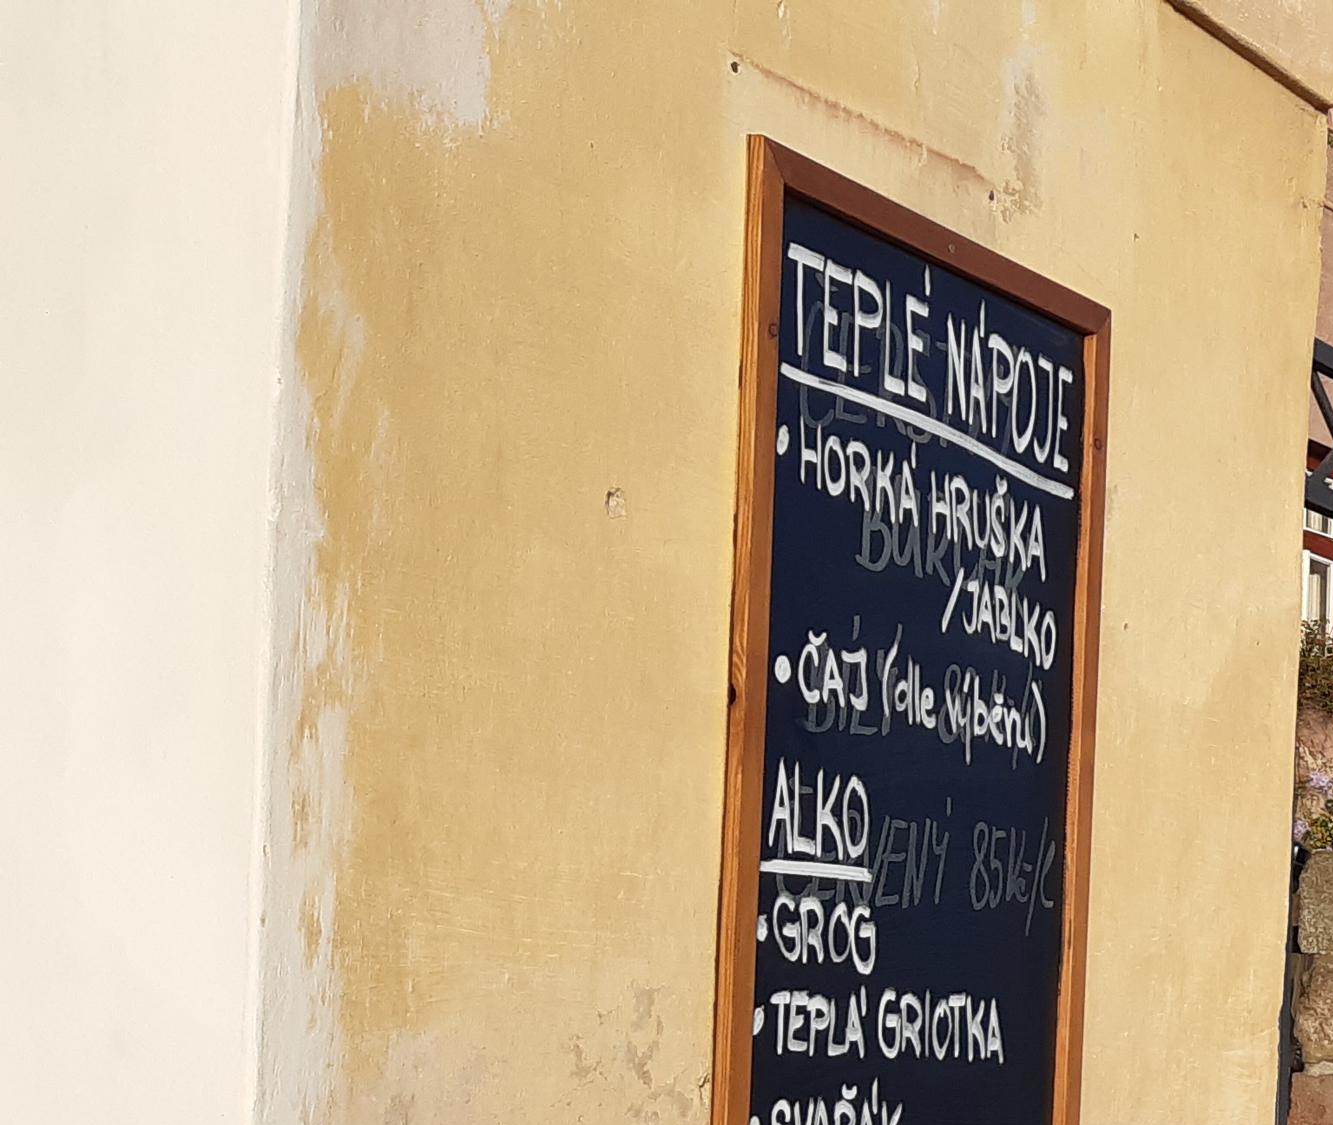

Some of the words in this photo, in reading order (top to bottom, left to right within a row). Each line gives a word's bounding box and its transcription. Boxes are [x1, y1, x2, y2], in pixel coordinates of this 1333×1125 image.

[787, 243, 931, 402] TEPLÉ
[947, 300, 1073, 472] NÁPOJE
[799, 414, 919, 528] HORKÁ
[930, 470, 1046, 583] HRUŠKA
[798, 630, 868, 712] ČAJ
[882, 624, 936, 730] (dle
[768, 756, 870, 861] ALKO
[772, 895, 877, 976] GROG
[769, 986, 866, 1058] TEPLÁ
[878, 988, 1005, 1064] GRIOTKA
